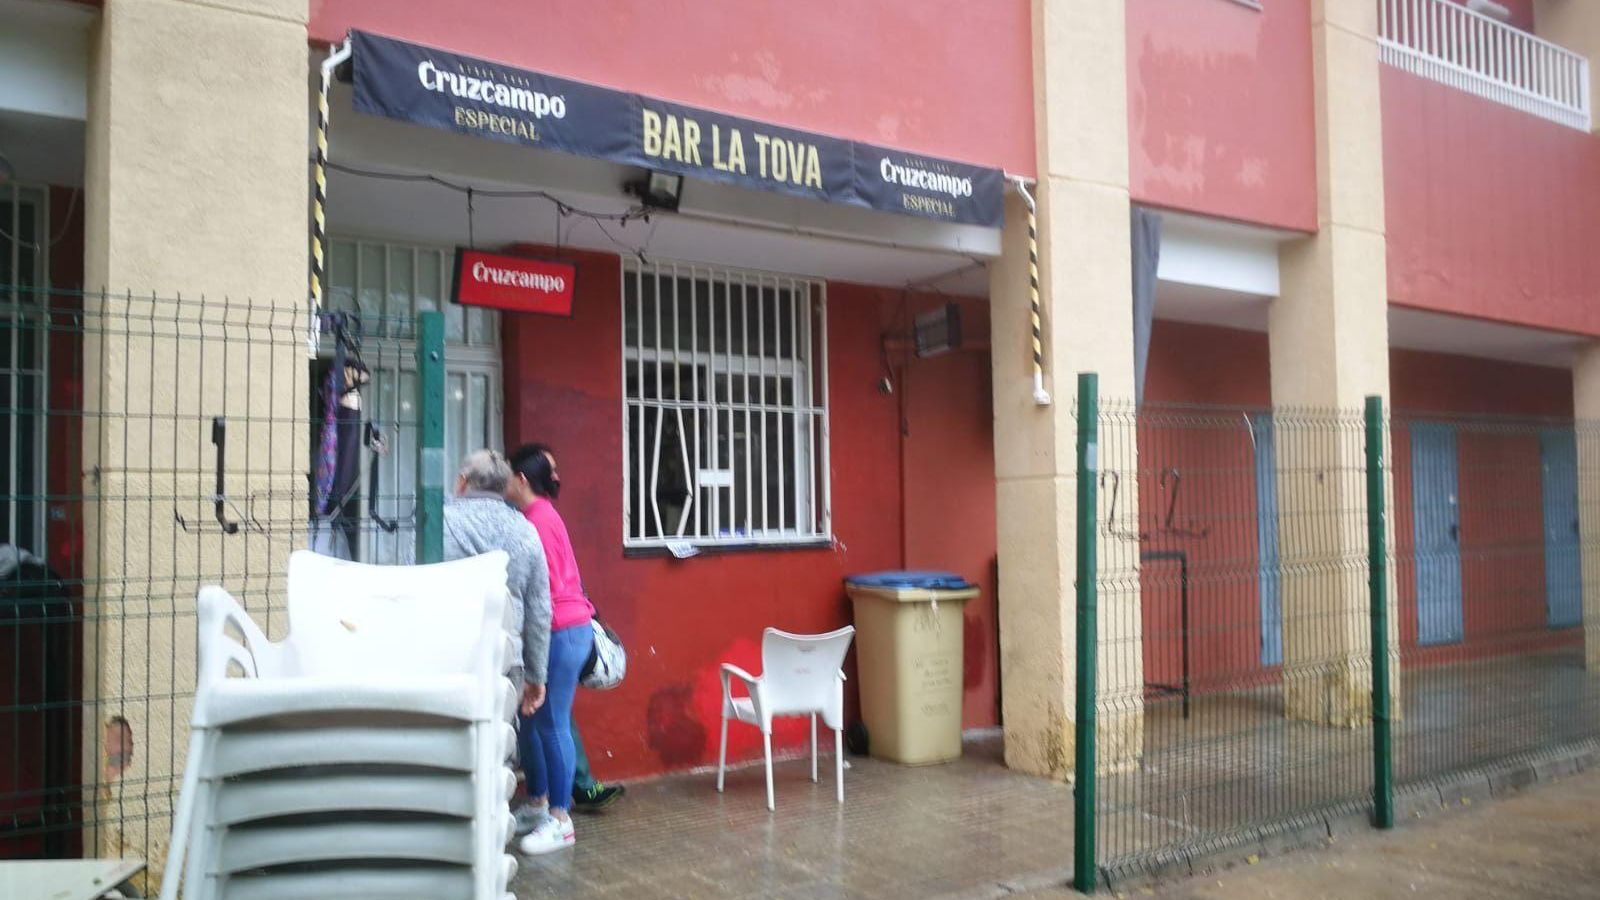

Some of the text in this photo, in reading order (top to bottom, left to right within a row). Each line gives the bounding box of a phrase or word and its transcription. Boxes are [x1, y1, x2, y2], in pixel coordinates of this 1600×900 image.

[418, 59, 566, 119] Cruzcampo
[454, 105, 541, 141] ESPECIAL
[643, 108, 823, 190] BAR LA TOVA
[880, 156, 972, 198] Cruzcampo
[903, 193, 955, 217] ESPECIAL
[472, 260, 565, 294] Cruzcampo
